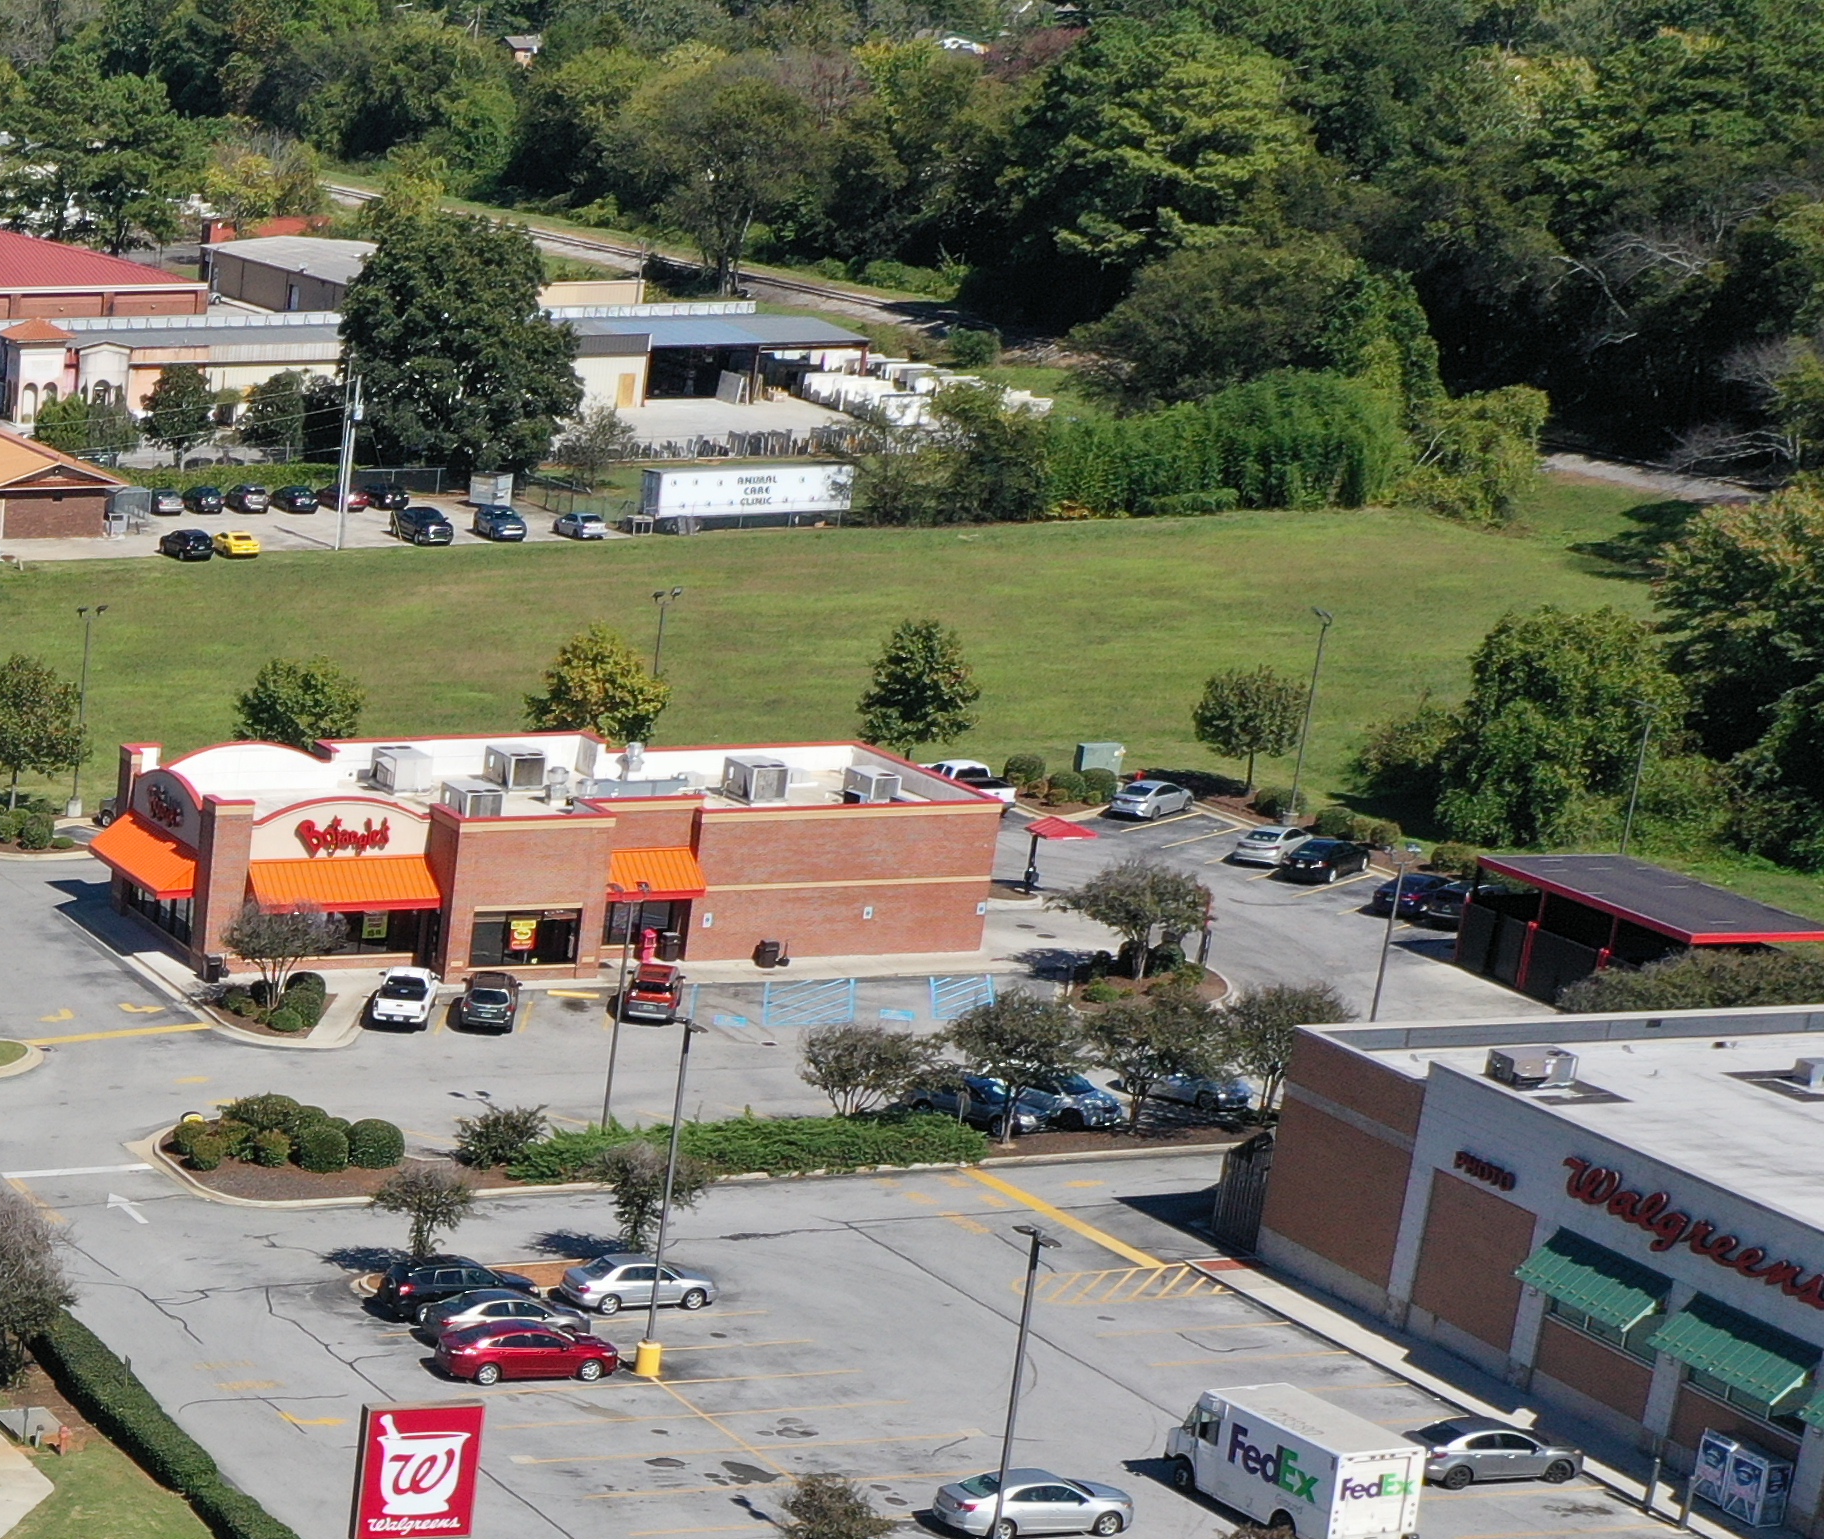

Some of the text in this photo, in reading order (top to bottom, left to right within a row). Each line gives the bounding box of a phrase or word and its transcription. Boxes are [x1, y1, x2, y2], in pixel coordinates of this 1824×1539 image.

[737, 475, 778, 485] ANIMAL
[743, 486, 771, 496] CARE
[740, 496, 772, 506] CLINIC
[1453, 1150, 1516, 1192] PHOTO
[1562, 1156, 1824, 1311] Walgreens
[1227, 1421, 1320, 1505] FedEx
[1340, 1472, 1415, 1502] FedEx
[367, 1516, 461, 1536] Walgreens
